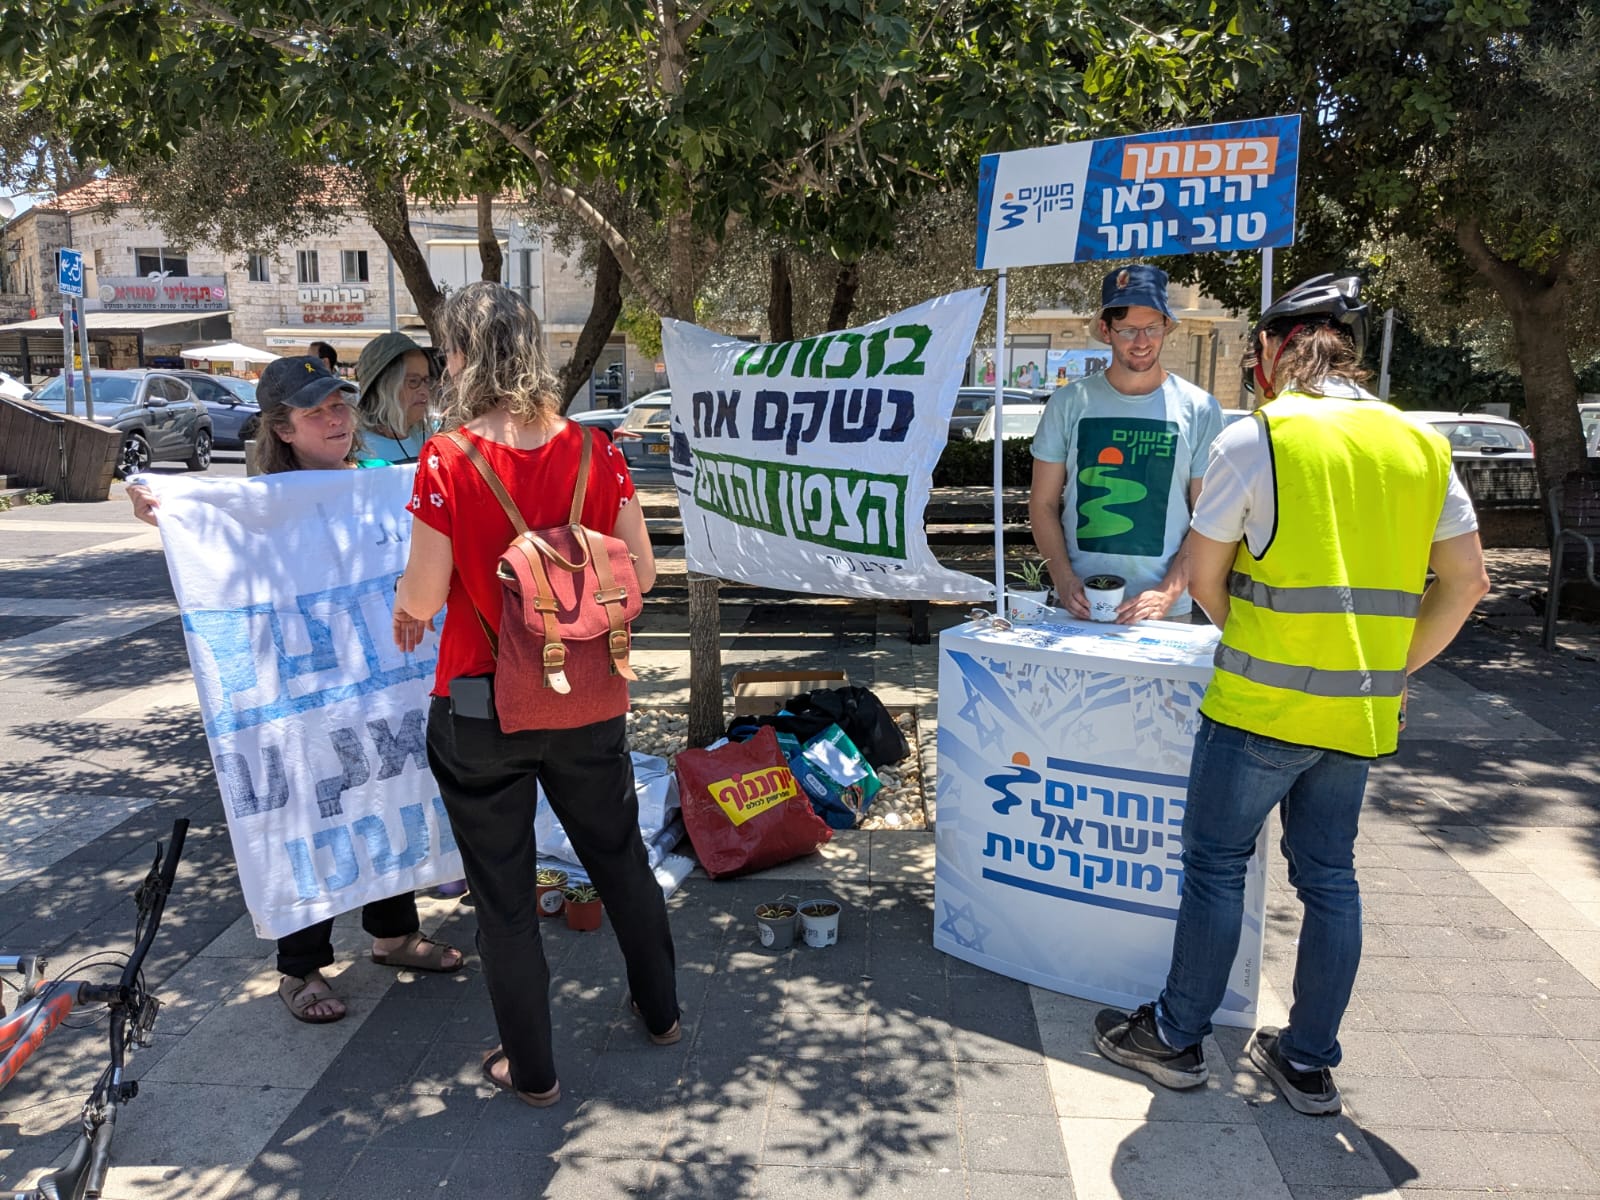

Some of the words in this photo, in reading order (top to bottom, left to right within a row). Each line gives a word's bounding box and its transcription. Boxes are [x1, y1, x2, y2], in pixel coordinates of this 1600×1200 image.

[1127, 141, 1269, 184] בזכותך
[1018, 182, 1075, 207] משנים
[1036, 197, 1074, 223] כיוון
[1101, 182, 1165, 224] כאן
[1178, 174, 1269, 208] יהיה
[1097, 219, 1178, 252] יותר
[1191, 211, 1267, 245] טוב
[751, 388, 915, 456] נשקם
[1112, 429, 1172, 448] משנים
[1130, 443, 1171, 465] כיוון
[778, 468, 899, 549] הצפון
[718, 768, 792, 812] יוחננוף
[1044, 778, 1187, 827] בוחרים
[982, 831, 1185, 896] דמוקרטית
